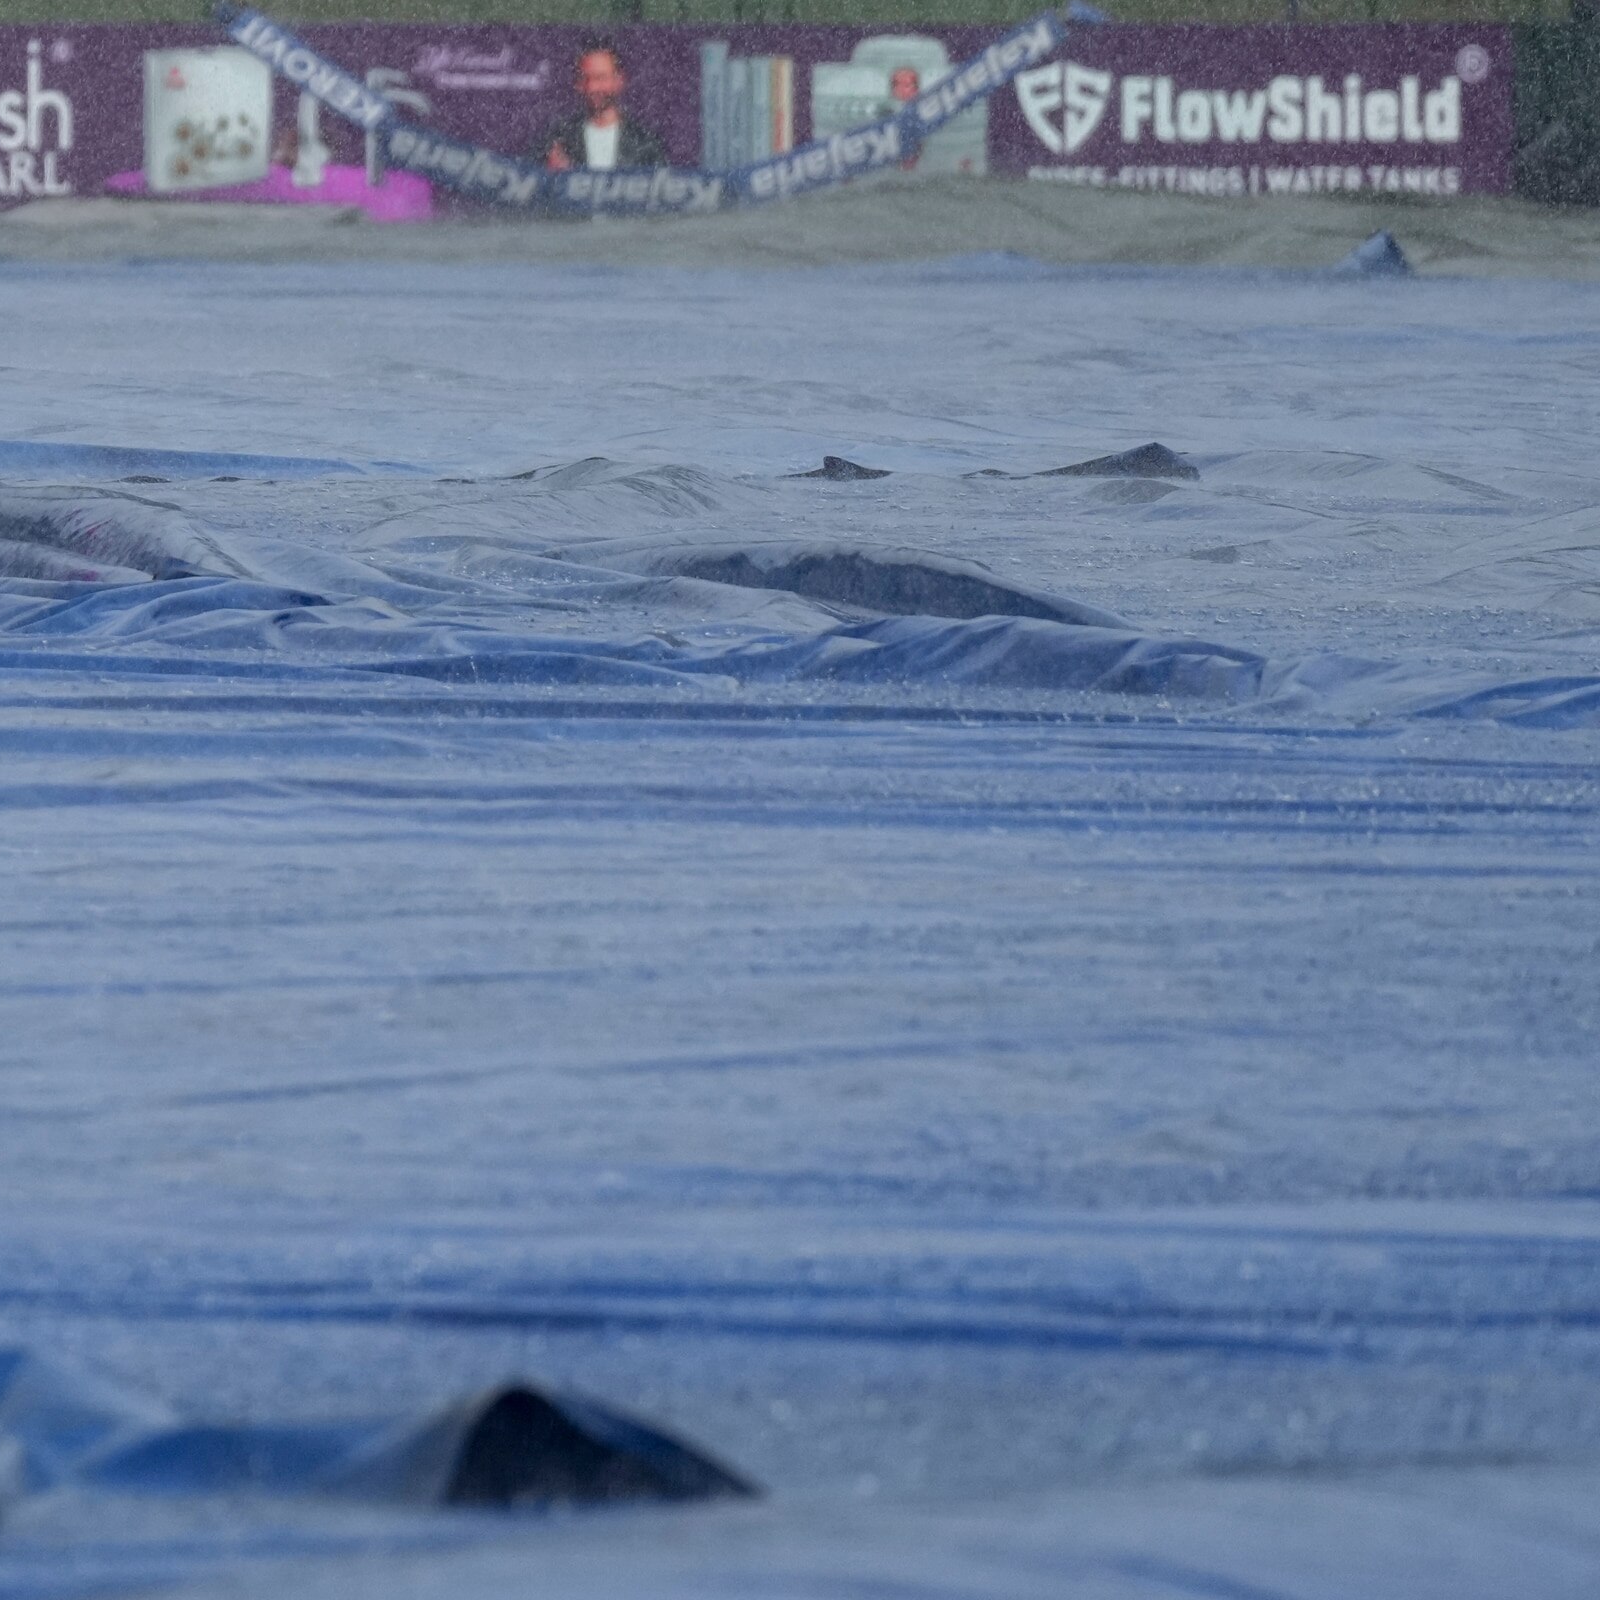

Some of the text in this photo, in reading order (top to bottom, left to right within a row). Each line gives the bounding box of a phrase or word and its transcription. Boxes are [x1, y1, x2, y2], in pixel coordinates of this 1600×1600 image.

[232, 14, 387, 124] KEROVIT
[918, 19, 1053, 120] Kajaria
[1120, 74, 1462, 144] FlowShield
[390, 129, 537, 203] Kajaria
[566, 172, 721, 208] Kajaria
[751, 125, 900, 198] Kajaria
